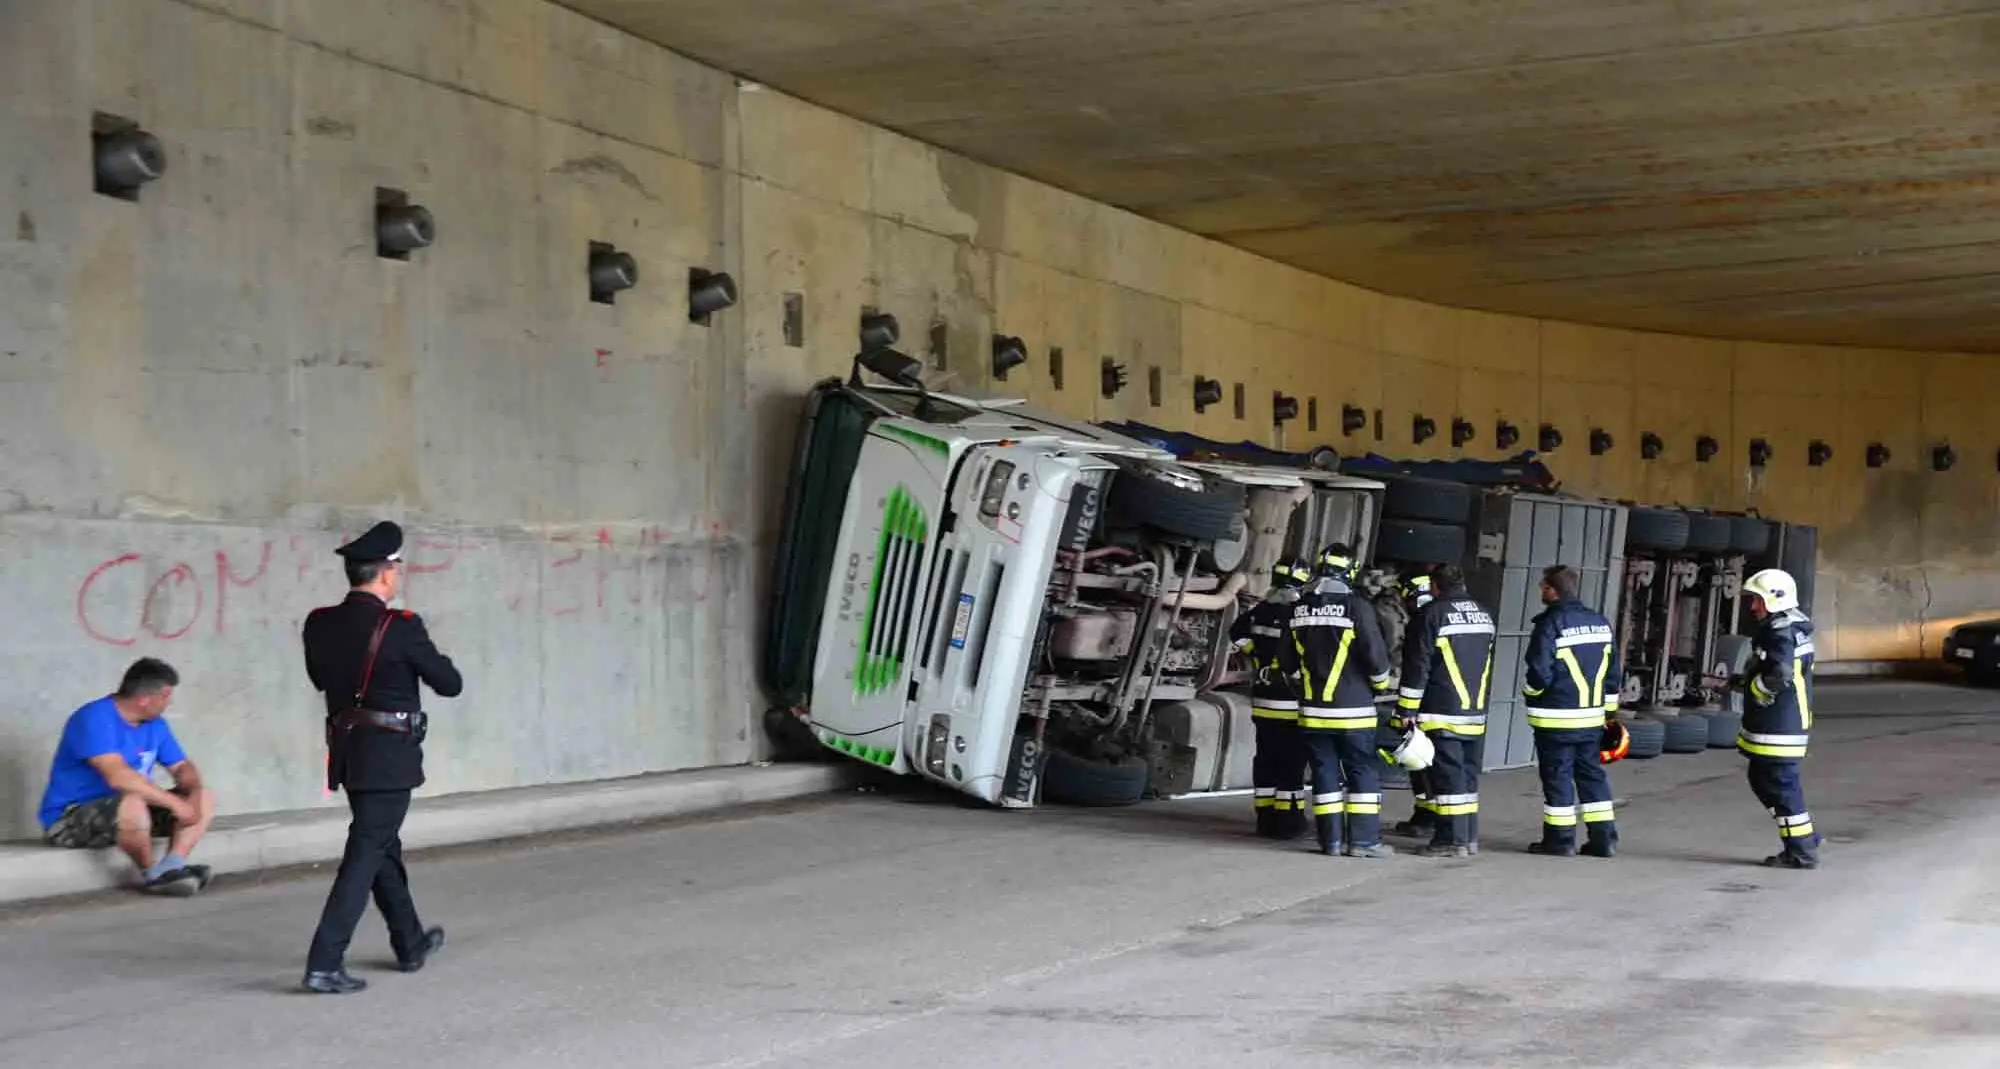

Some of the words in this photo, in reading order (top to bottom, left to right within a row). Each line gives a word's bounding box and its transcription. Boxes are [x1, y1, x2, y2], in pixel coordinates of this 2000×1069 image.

[1072, 490, 1098, 551] IVECO
[839, 552, 861, 622] IVECO
[1294, 604, 1310, 617] DEL
[1447, 612, 1467, 624] DEL
[1015, 741, 1036, 800] IVECO
